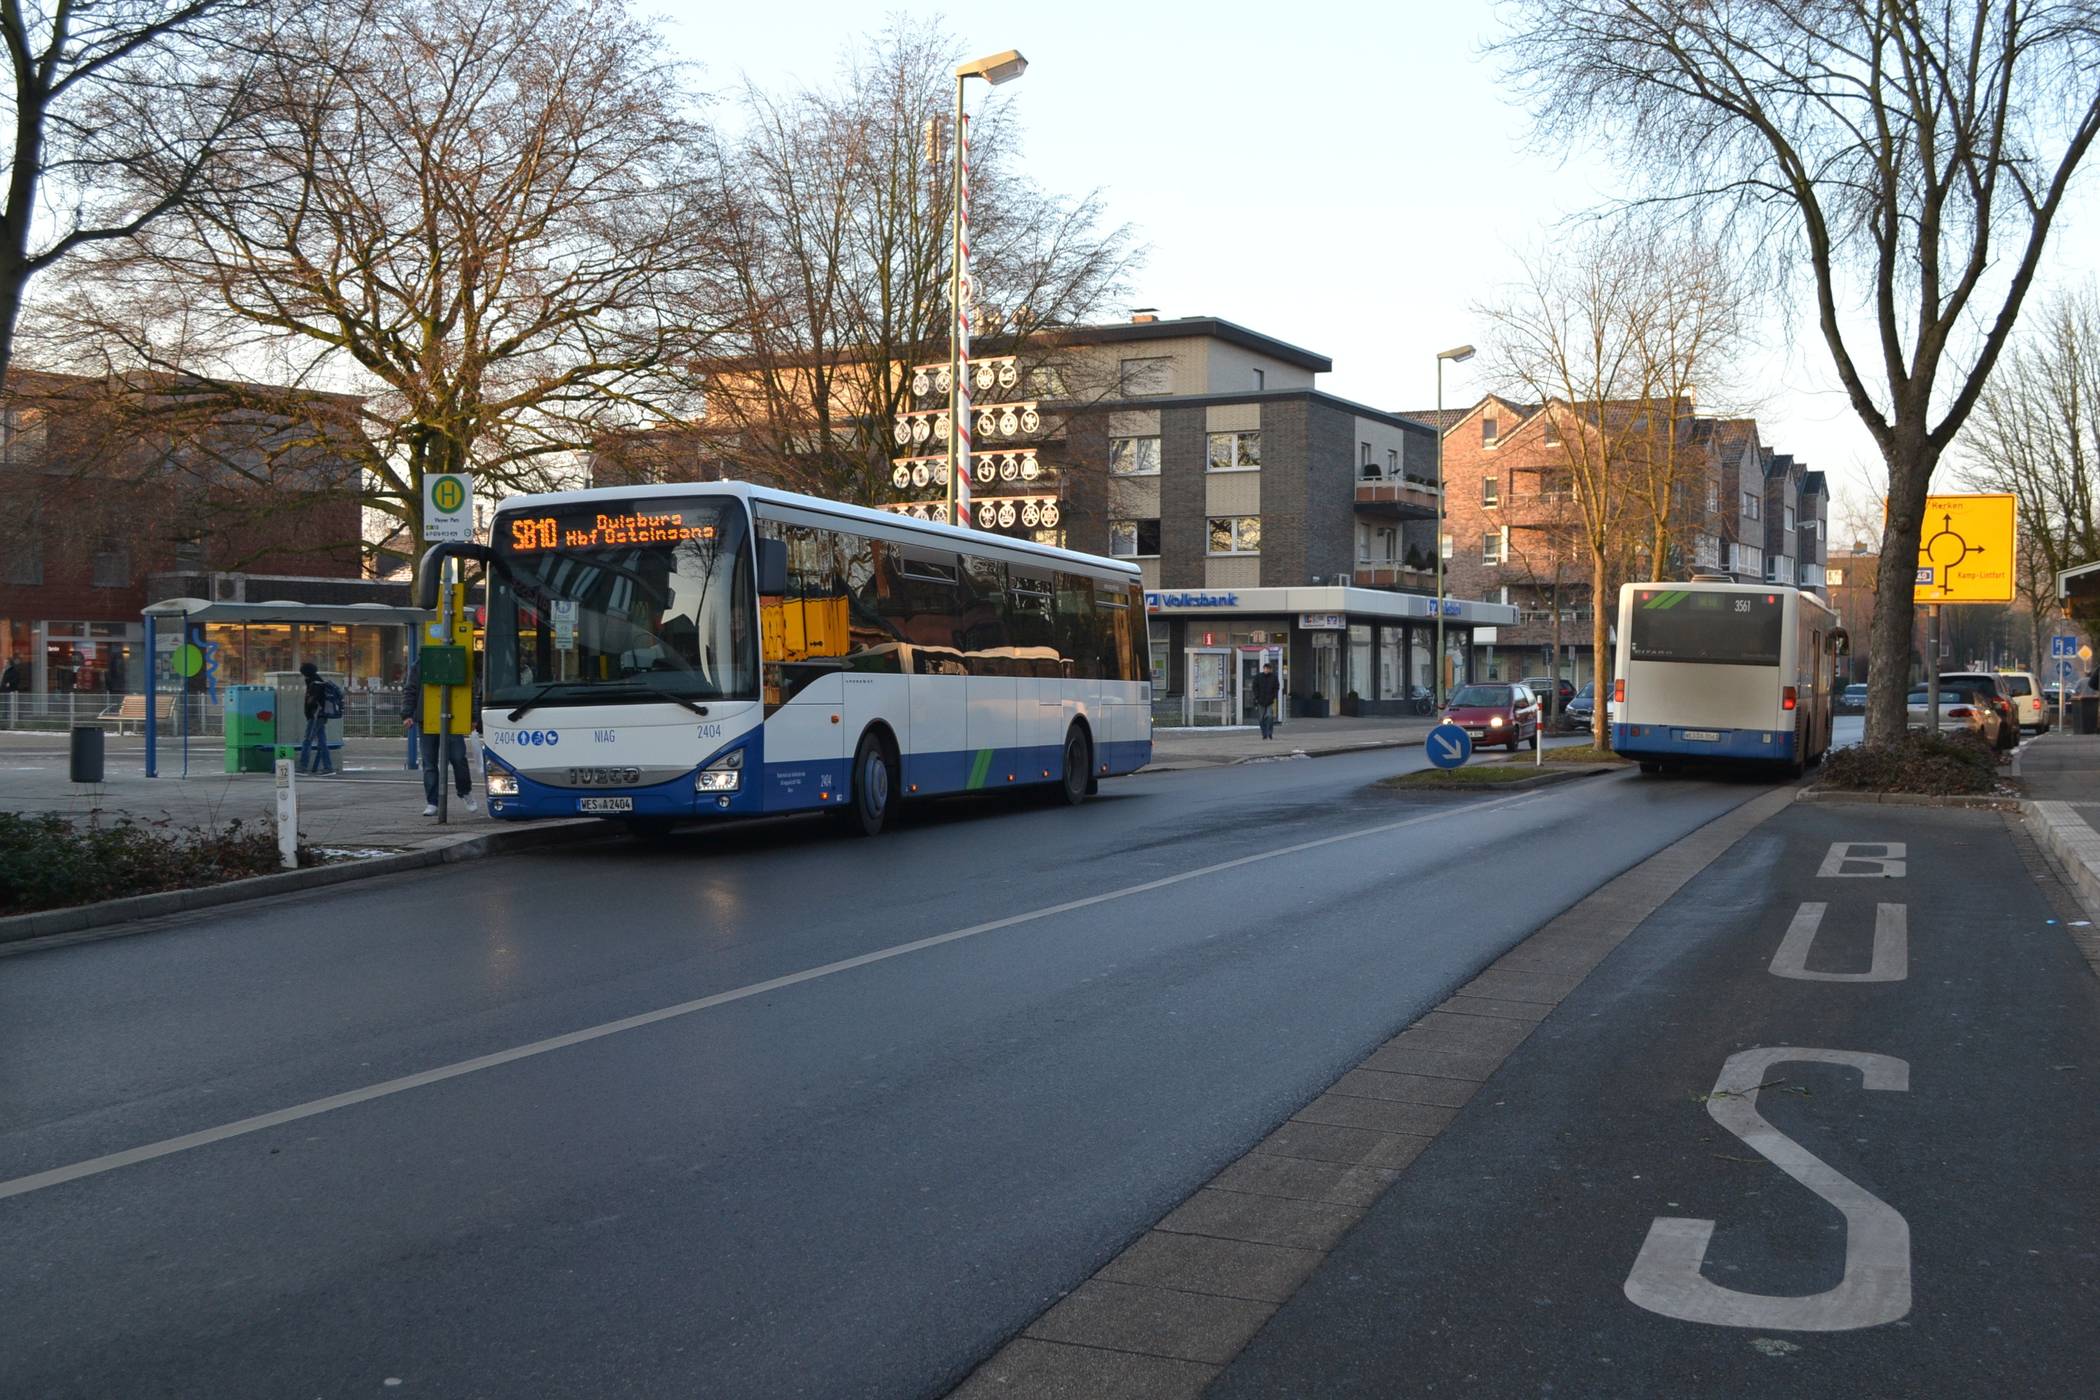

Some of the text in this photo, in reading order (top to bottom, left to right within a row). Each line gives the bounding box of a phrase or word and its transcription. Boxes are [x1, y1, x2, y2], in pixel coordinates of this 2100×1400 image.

[441, 483, 455, 505] H
[596, 511, 683, 530] Duisburg
[512, 517, 558, 549] SB10
[565, 529, 598, 546] Hbf
[1162, 592, 1239, 607] Volksbank
[1734, 600, 1751, 612] 3561
[494, 732, 515, 745] 2404
[594, 730, 616, 743] NIAG
[697, 725, 721, 739] 2404
[569, 768, 641, 785] IVECO
[581, 799, 598, 809] WES
